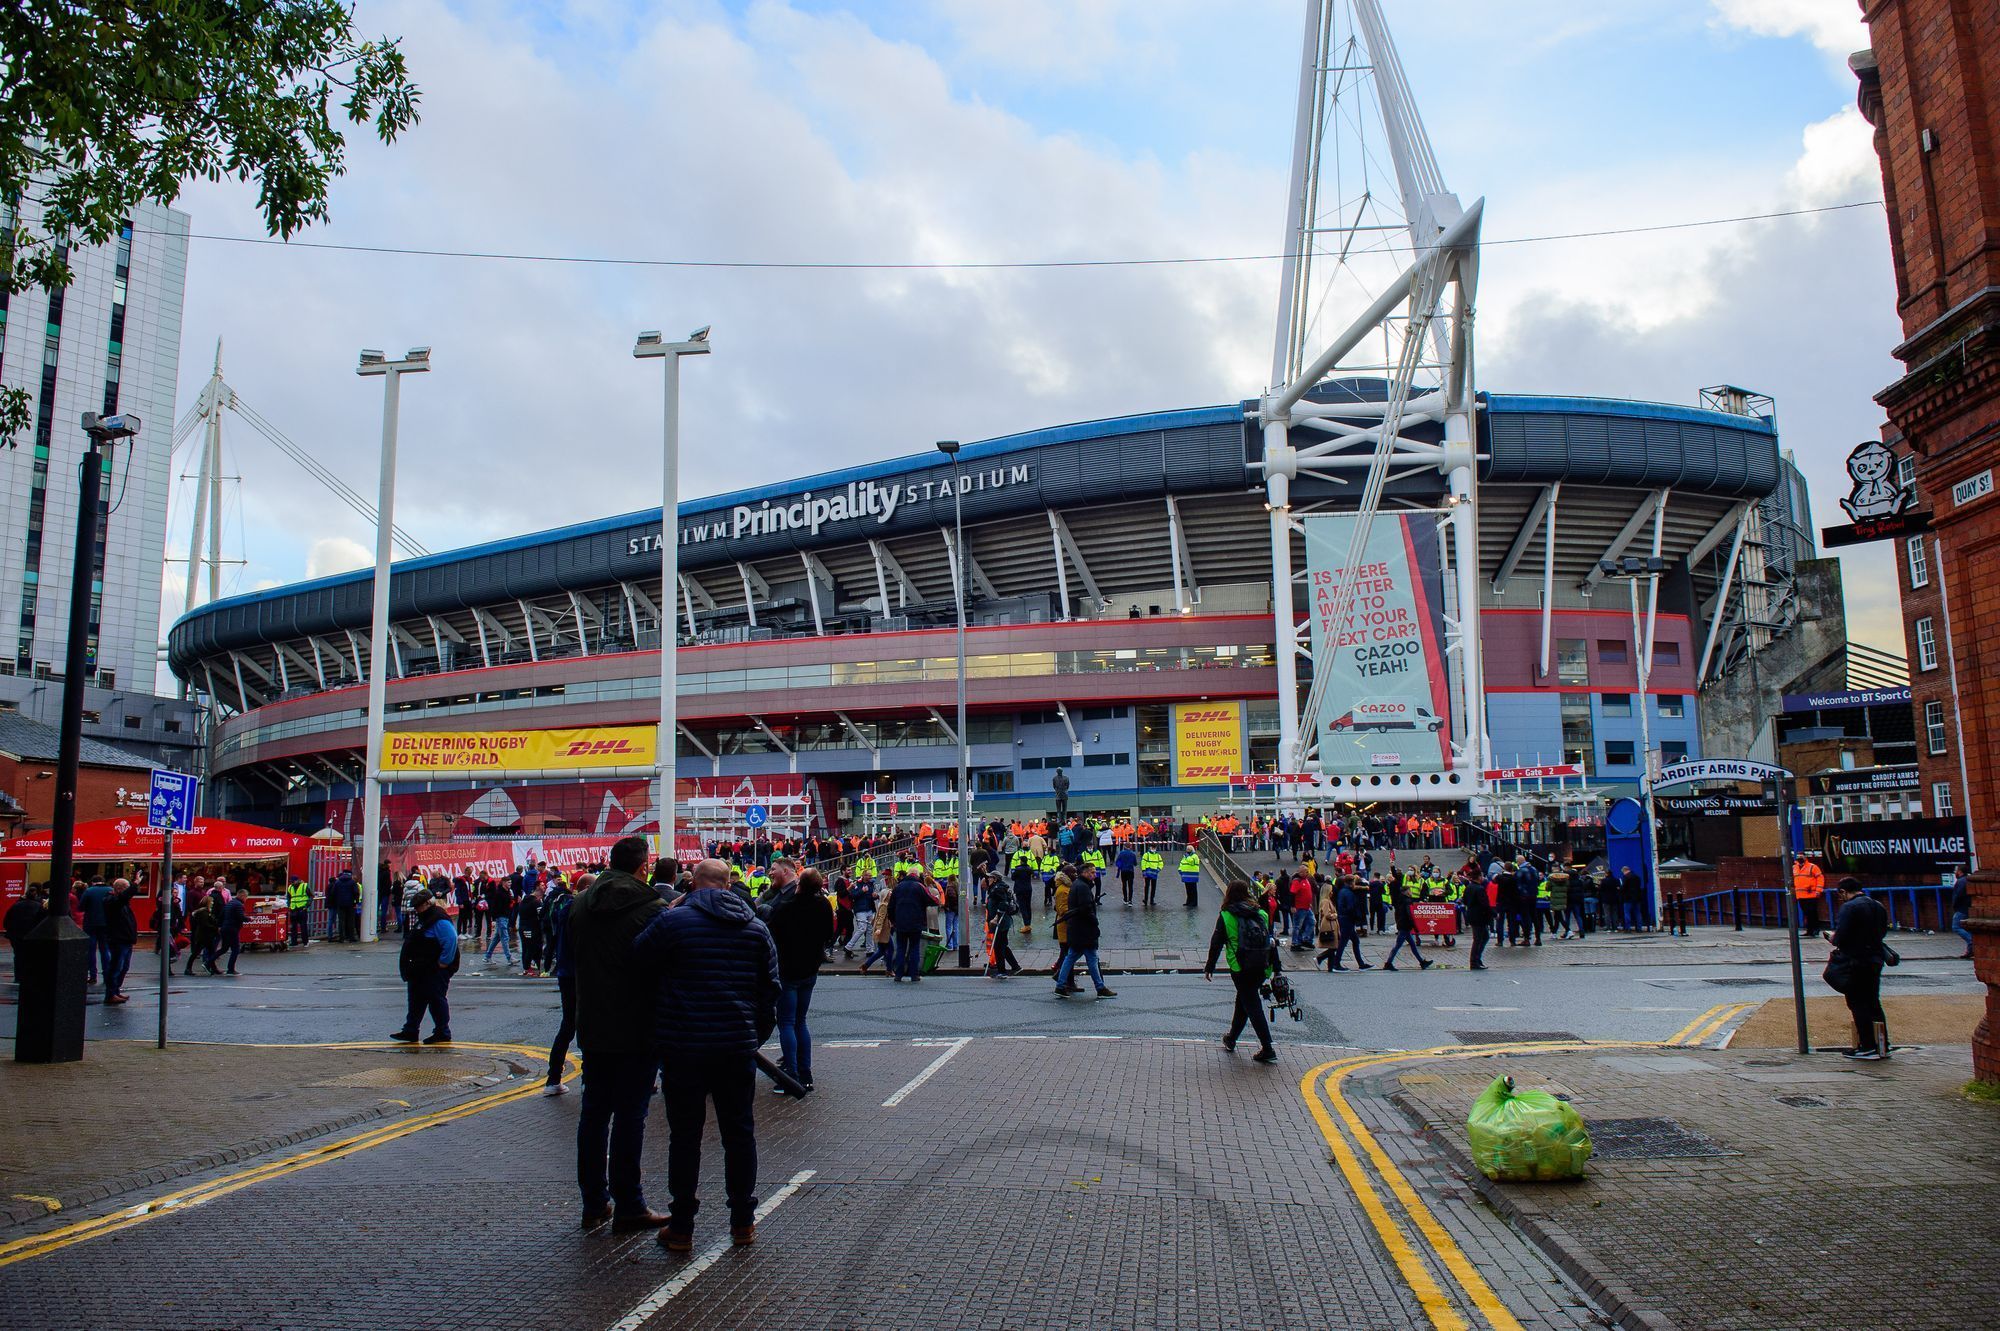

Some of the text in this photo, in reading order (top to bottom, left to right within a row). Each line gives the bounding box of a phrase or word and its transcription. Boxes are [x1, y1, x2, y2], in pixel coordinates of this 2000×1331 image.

[906, 464, 1029, 504] STADIUM
[1956, 480, 1977, 503] QUAY
[733, 482, 900, 538] Principality
[1855, 524, 1876, 538] Tiny
[629, 522, 727, 555] STAIWM
[1313, 571, 1332, 585] IS
[1317, 587, 1329, 601] A
[1360, 595, 1385, 610] TO
[1360, 608, 1408, 626] YOUR
[1372, 622, 1417, 641] CAR?
[1354, 641, 1419, 661] CAZOO
[1357, 659, 1409, 677] YEAH!
[1808, 696, 1848, 706] Welcome
[1850, 695, 1860, 703] to
[1861, 693, 1873, 702] BT
[1875, 691, 1902, 703] Sport
[1360, 704, 1406, 713] CAZOO
[1183, 710, 1232, 723] DHL
[1186, 731, 1231, 739] DELIVERING
[392, 736, 528, 750] DELIVERING RUGBY
[566, 739, 634, 757] DHL
[391, 753, 409, 765] TO
[412, 753, 438, 765] THE
[1185, 766, 1231, 778] DHL
[1525, 769, 1543, 777] Gate
[1709, 764, 1747, 775] ARMS
[1750, 767, 1777, 779] PAR
[1872, 773, 1896, 781] CARDIFF
[1897, 772, 1914, 780] ARMS
[1268, 775, 1287, 783] Gate
[1836, 783, 1852, 791] HOME
[1861, 782, 1872, 790] THE
[1873, 781, 1900, 789] OFFICIAL
[1900, 779, 1919, 787] GUINN
[1670, 798, 1720, 809] GUINNESS
[1724, 799, 1742, 807] FAN
[135, 826, 165, 835] WELS
[135, 837, 162, 845] Official
[246, 838, 282, 847] macron
[1840, 836, 1966, 855] GUINNESS FAN VILLAGE
[415, 848, 477, 860] THIS IS OUR GAME
[544, 847, 590, 867] LIMITED
